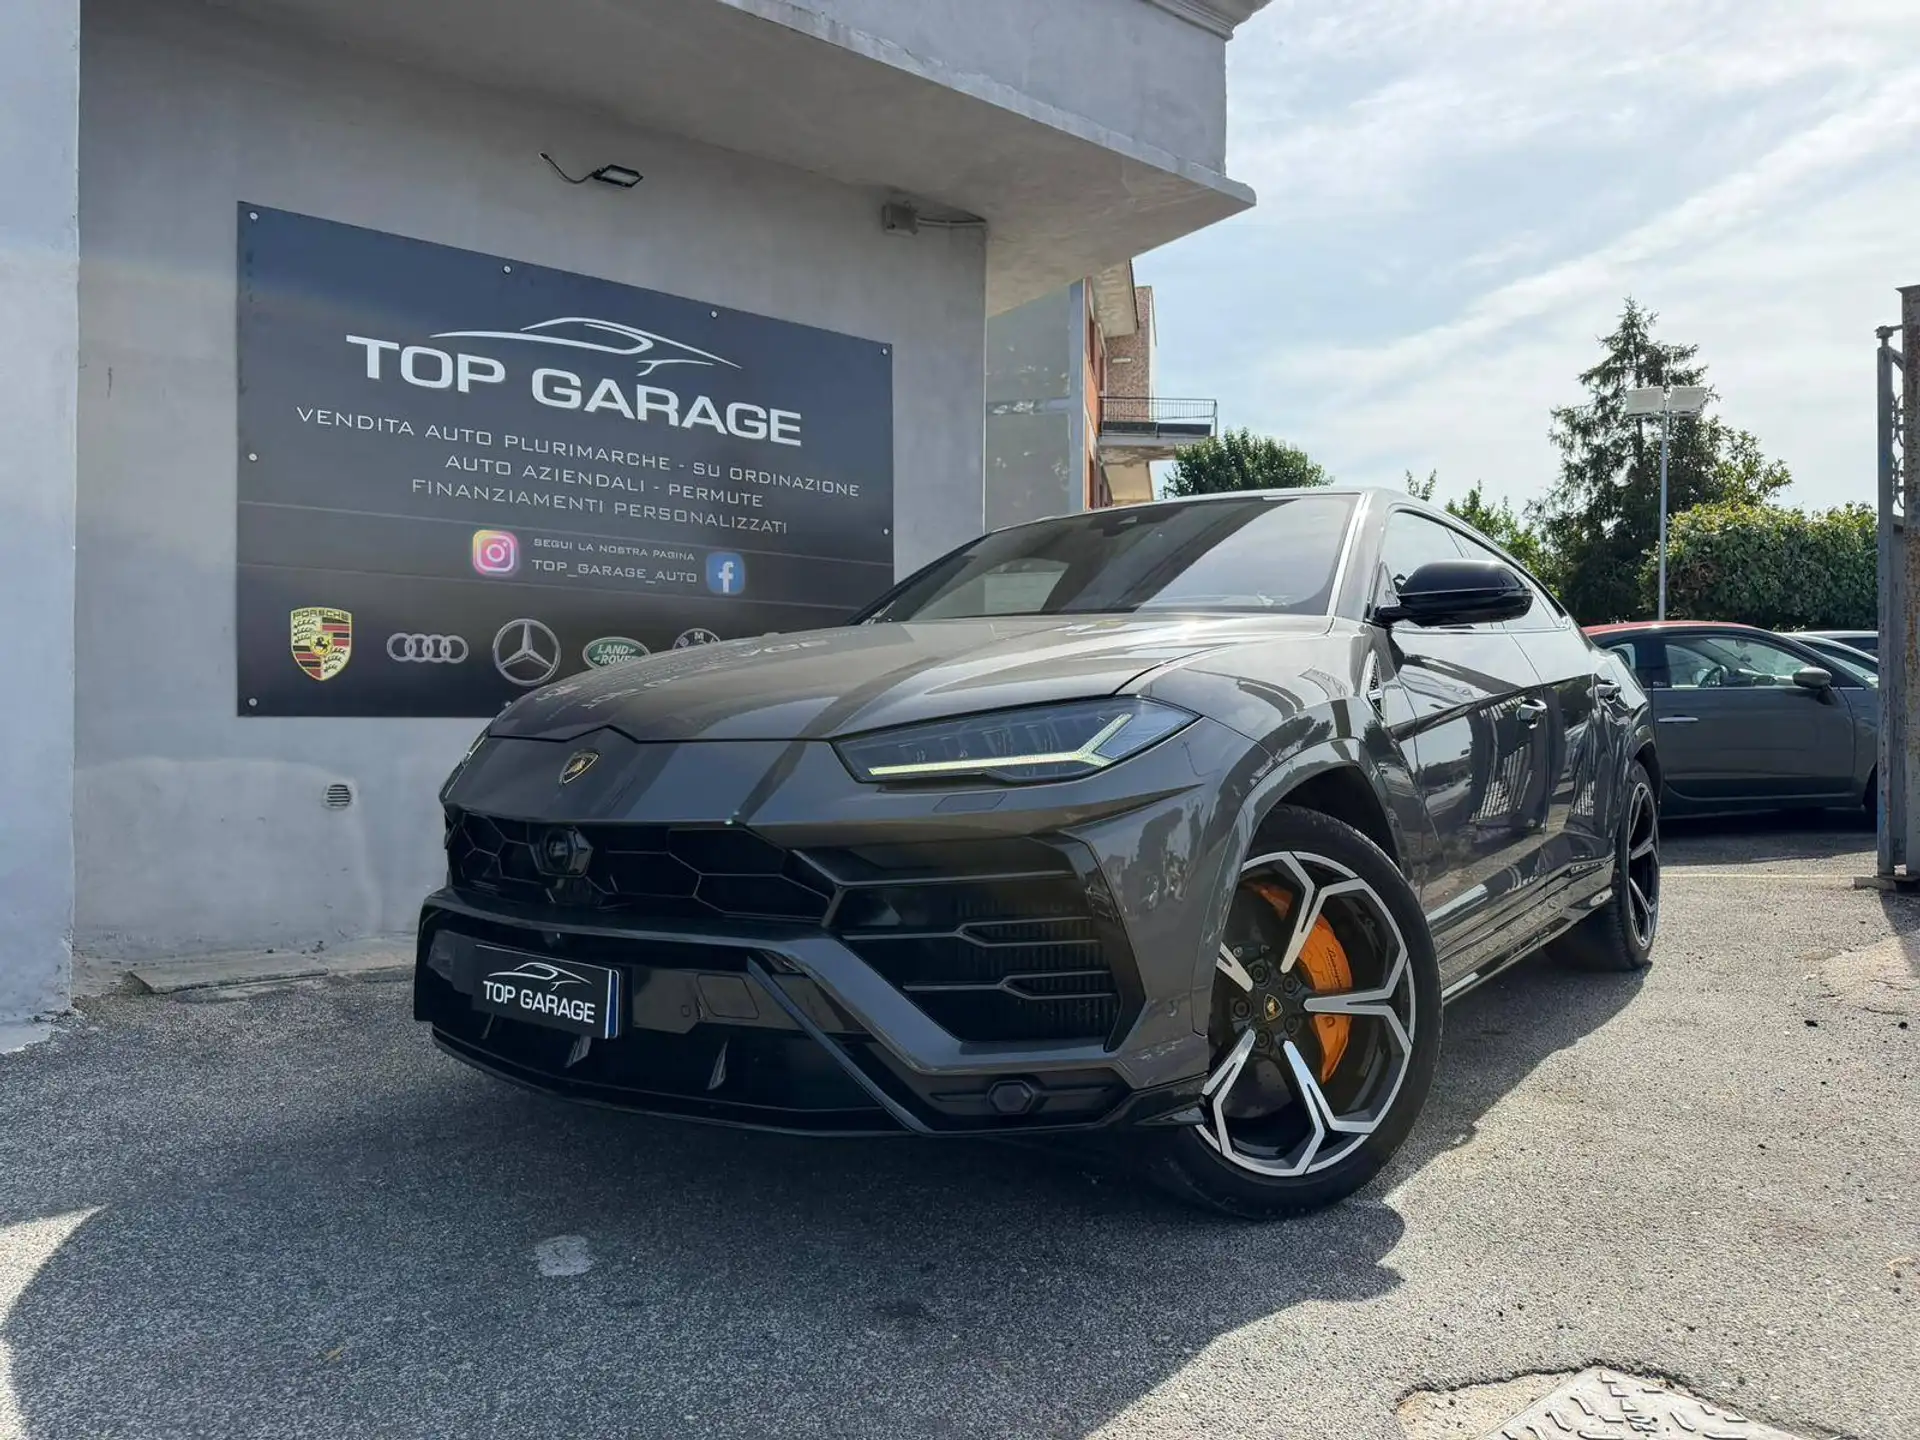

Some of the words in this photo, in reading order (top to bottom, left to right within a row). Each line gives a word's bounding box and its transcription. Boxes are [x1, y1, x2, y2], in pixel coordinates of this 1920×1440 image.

[345, 334, 506, 393] TOP
[531, 367, 803, 447] GARAGE
[296, 405, 415, 437] VENDITA
[424, 424, 493, 446] AUTO
[504, 434, 672, 472] PLURIMARCHE
[692, 461, 721, 478] SU
[729, 466, 861, 498] ORDINAZIONE
[444, 454, 512, 476] AUTO
[521, 463, 645, 493] AZIENDALI
[668, 482, 764, 508] PERMUTE
[411, 478, 604, 515] FINANZIAMENTI
[613, 501, 788, 535] PERSONALIZZATI
[533, 537, 574, 551] SEGUI
[577, 542, 595, 552] LA
[598, 543, 649, 557] NOSTRA
[652, 548, 696, 562] PAGINA
[531, 558, 698, 585] TOP_GARAGE_AUTO
[292, 608, 350, 622] PORSCHE
[597, 643, 630, 656] LAND
[599, 653, 634, 665] ROVE
[482, 980, 517, 1005] TOP
[519, 988, 597, 1025] GARAGE
